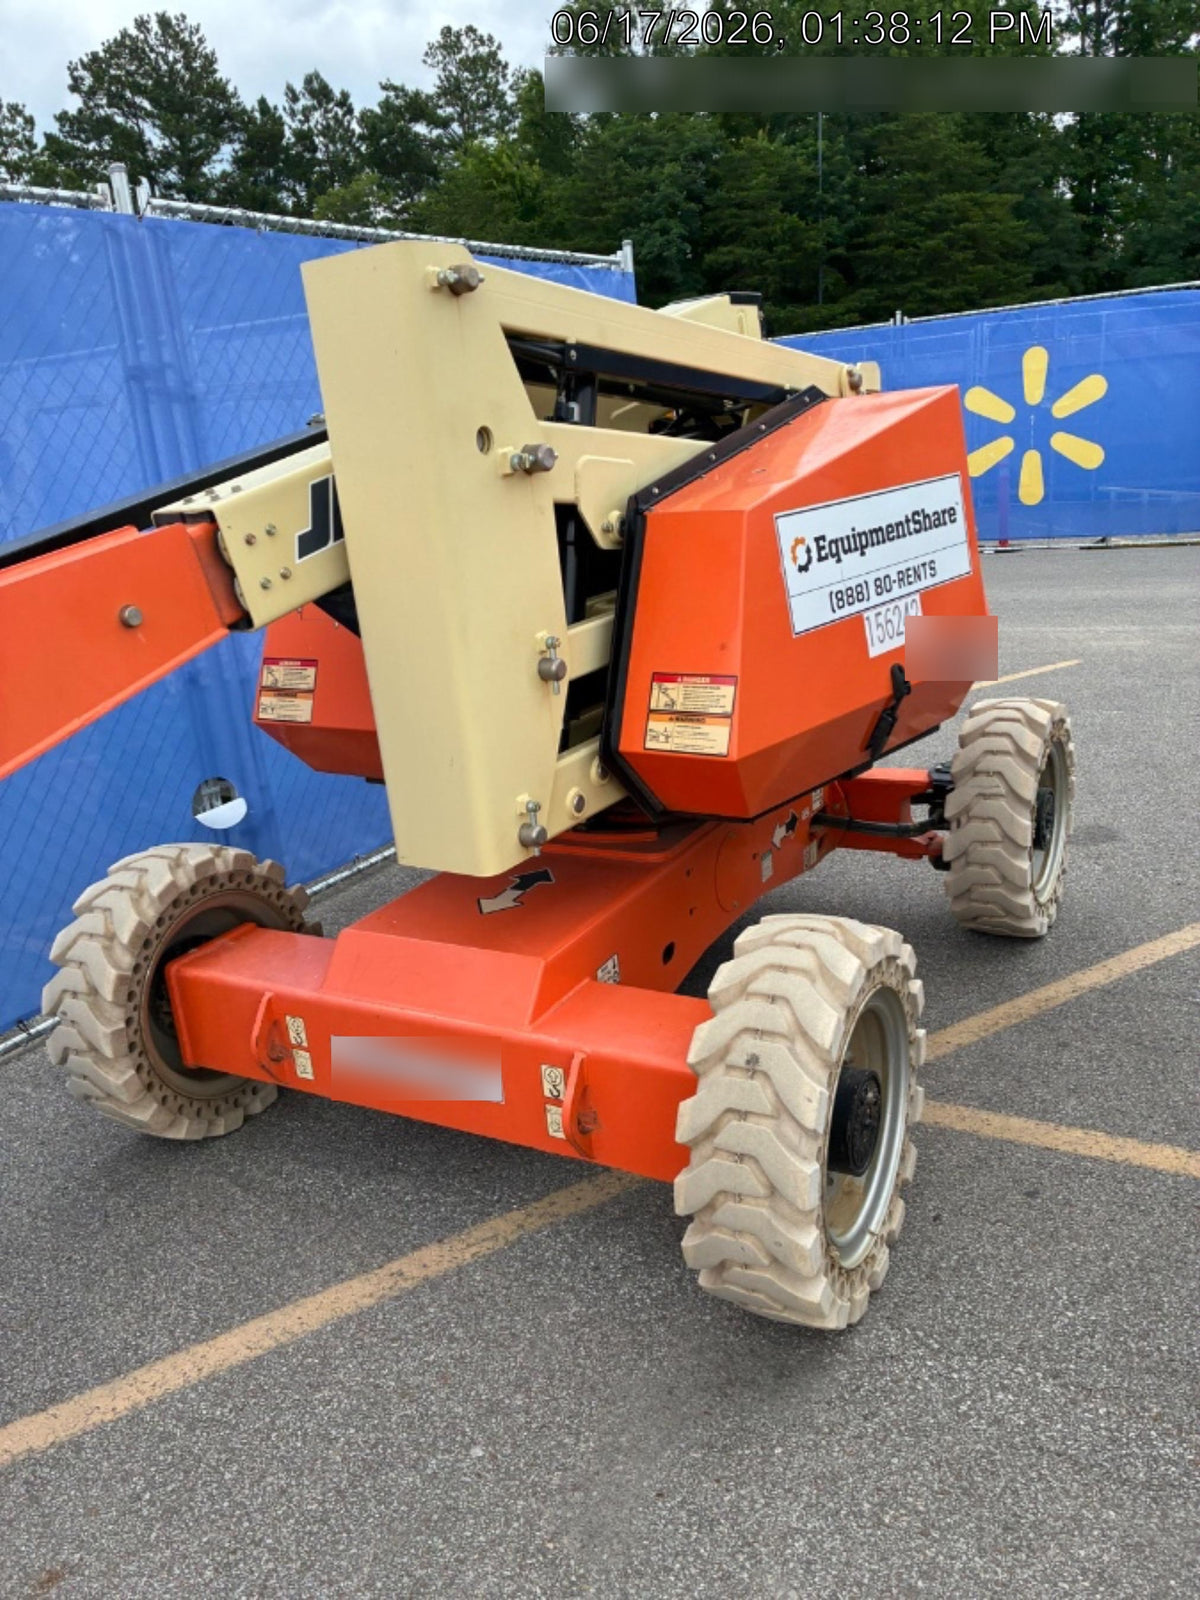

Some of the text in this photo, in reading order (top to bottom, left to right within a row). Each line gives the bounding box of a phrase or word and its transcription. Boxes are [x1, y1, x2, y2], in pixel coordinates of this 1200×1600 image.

[295, 474, 345, 564] J
[814, 505, 957, 563] EquipmentShare
[829, 559, 938, 613] (888) 80-RENTS
